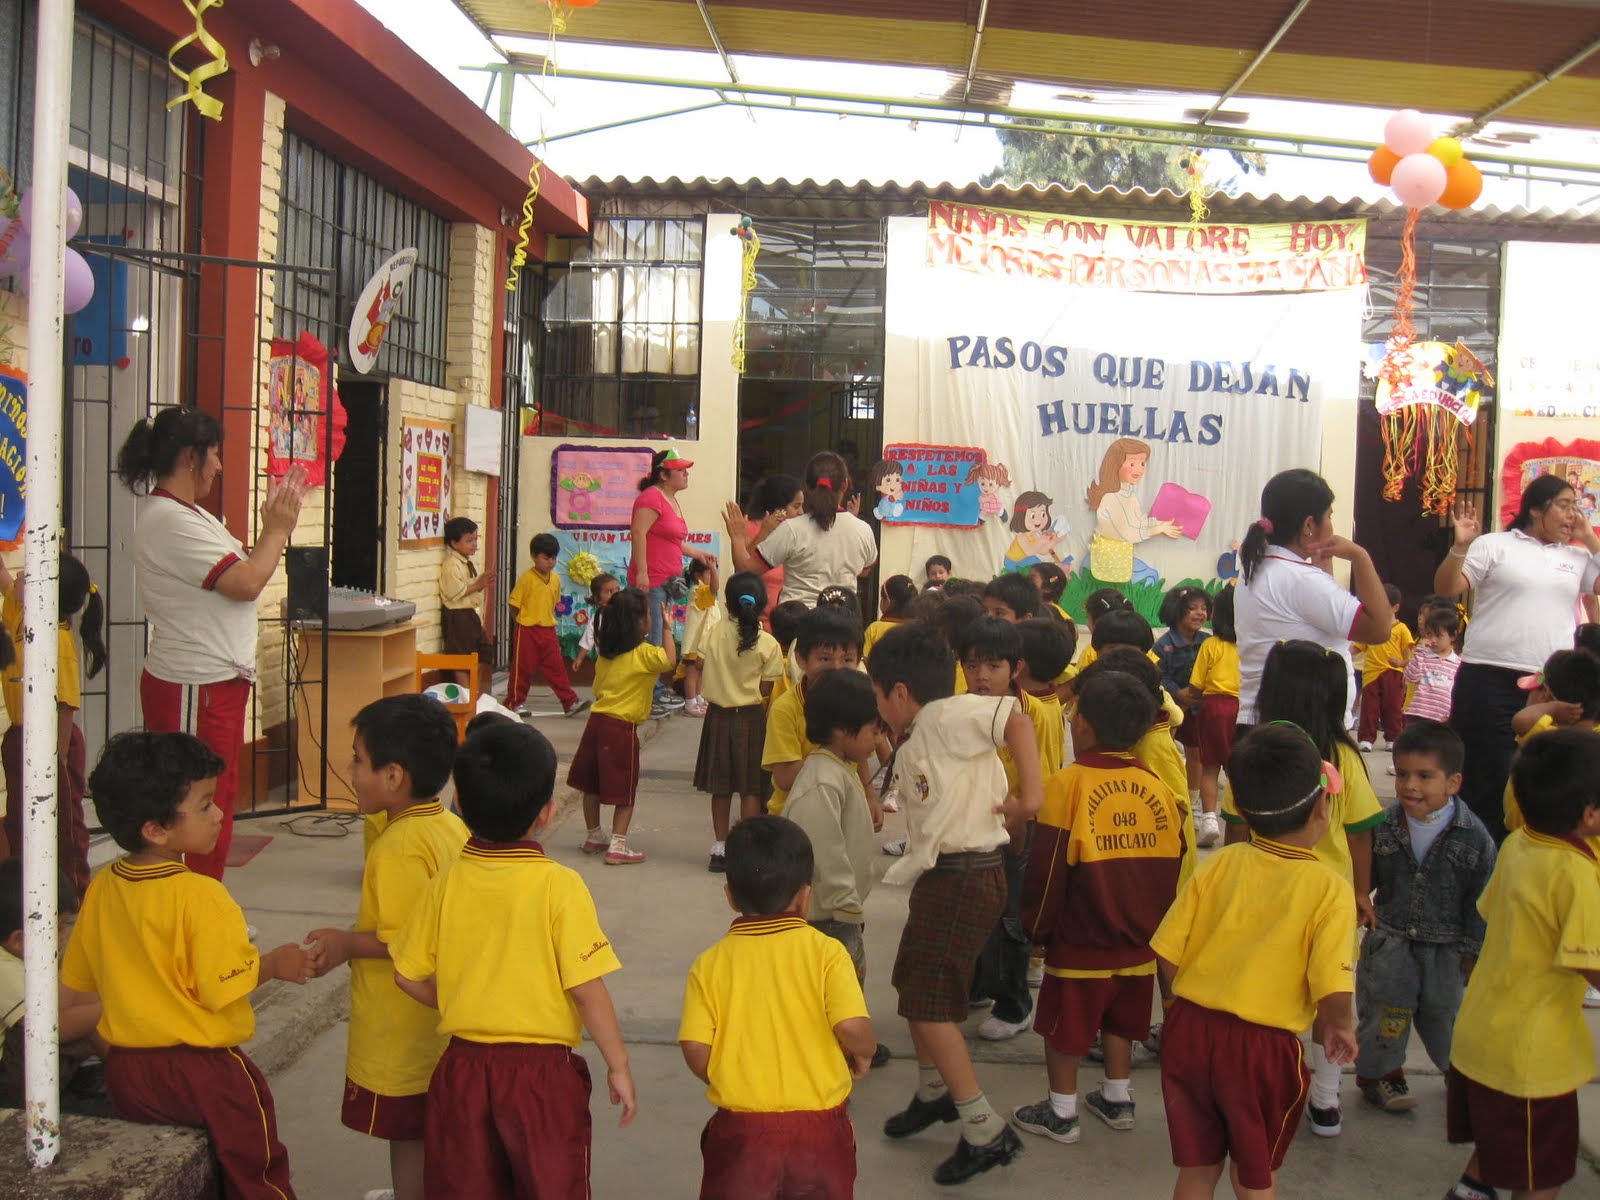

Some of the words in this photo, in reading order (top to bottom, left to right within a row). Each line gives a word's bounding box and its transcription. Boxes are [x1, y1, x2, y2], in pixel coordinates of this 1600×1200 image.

[1044, 219, 1108, 244] CON
[947, 335, 1068, 378] PASOS
[1093, 352, 1165, 390] QUE
[1187, 360, 1311, 403] DEJAN
[1037, 400, 1223, 446] HUELLAS
[888, 448, 983, 463] RESPETEMOS
[906, 463, 917, 474] A
[927, 464, 958, 476] LAS
[901, 478, 947, 494] NIÑAS
[953, 482, 962, 494] Y
[905, 497, 950, 513] NIÑOS
[573, 532, 615, 543] VIVAN
[1130, 781, 1148, 799] DE
[1144, 793, 1169, 831] JESUS
[1112, 811, 1137, 827] 048
[1095, 832, 1157, 851] CHICLAYO
